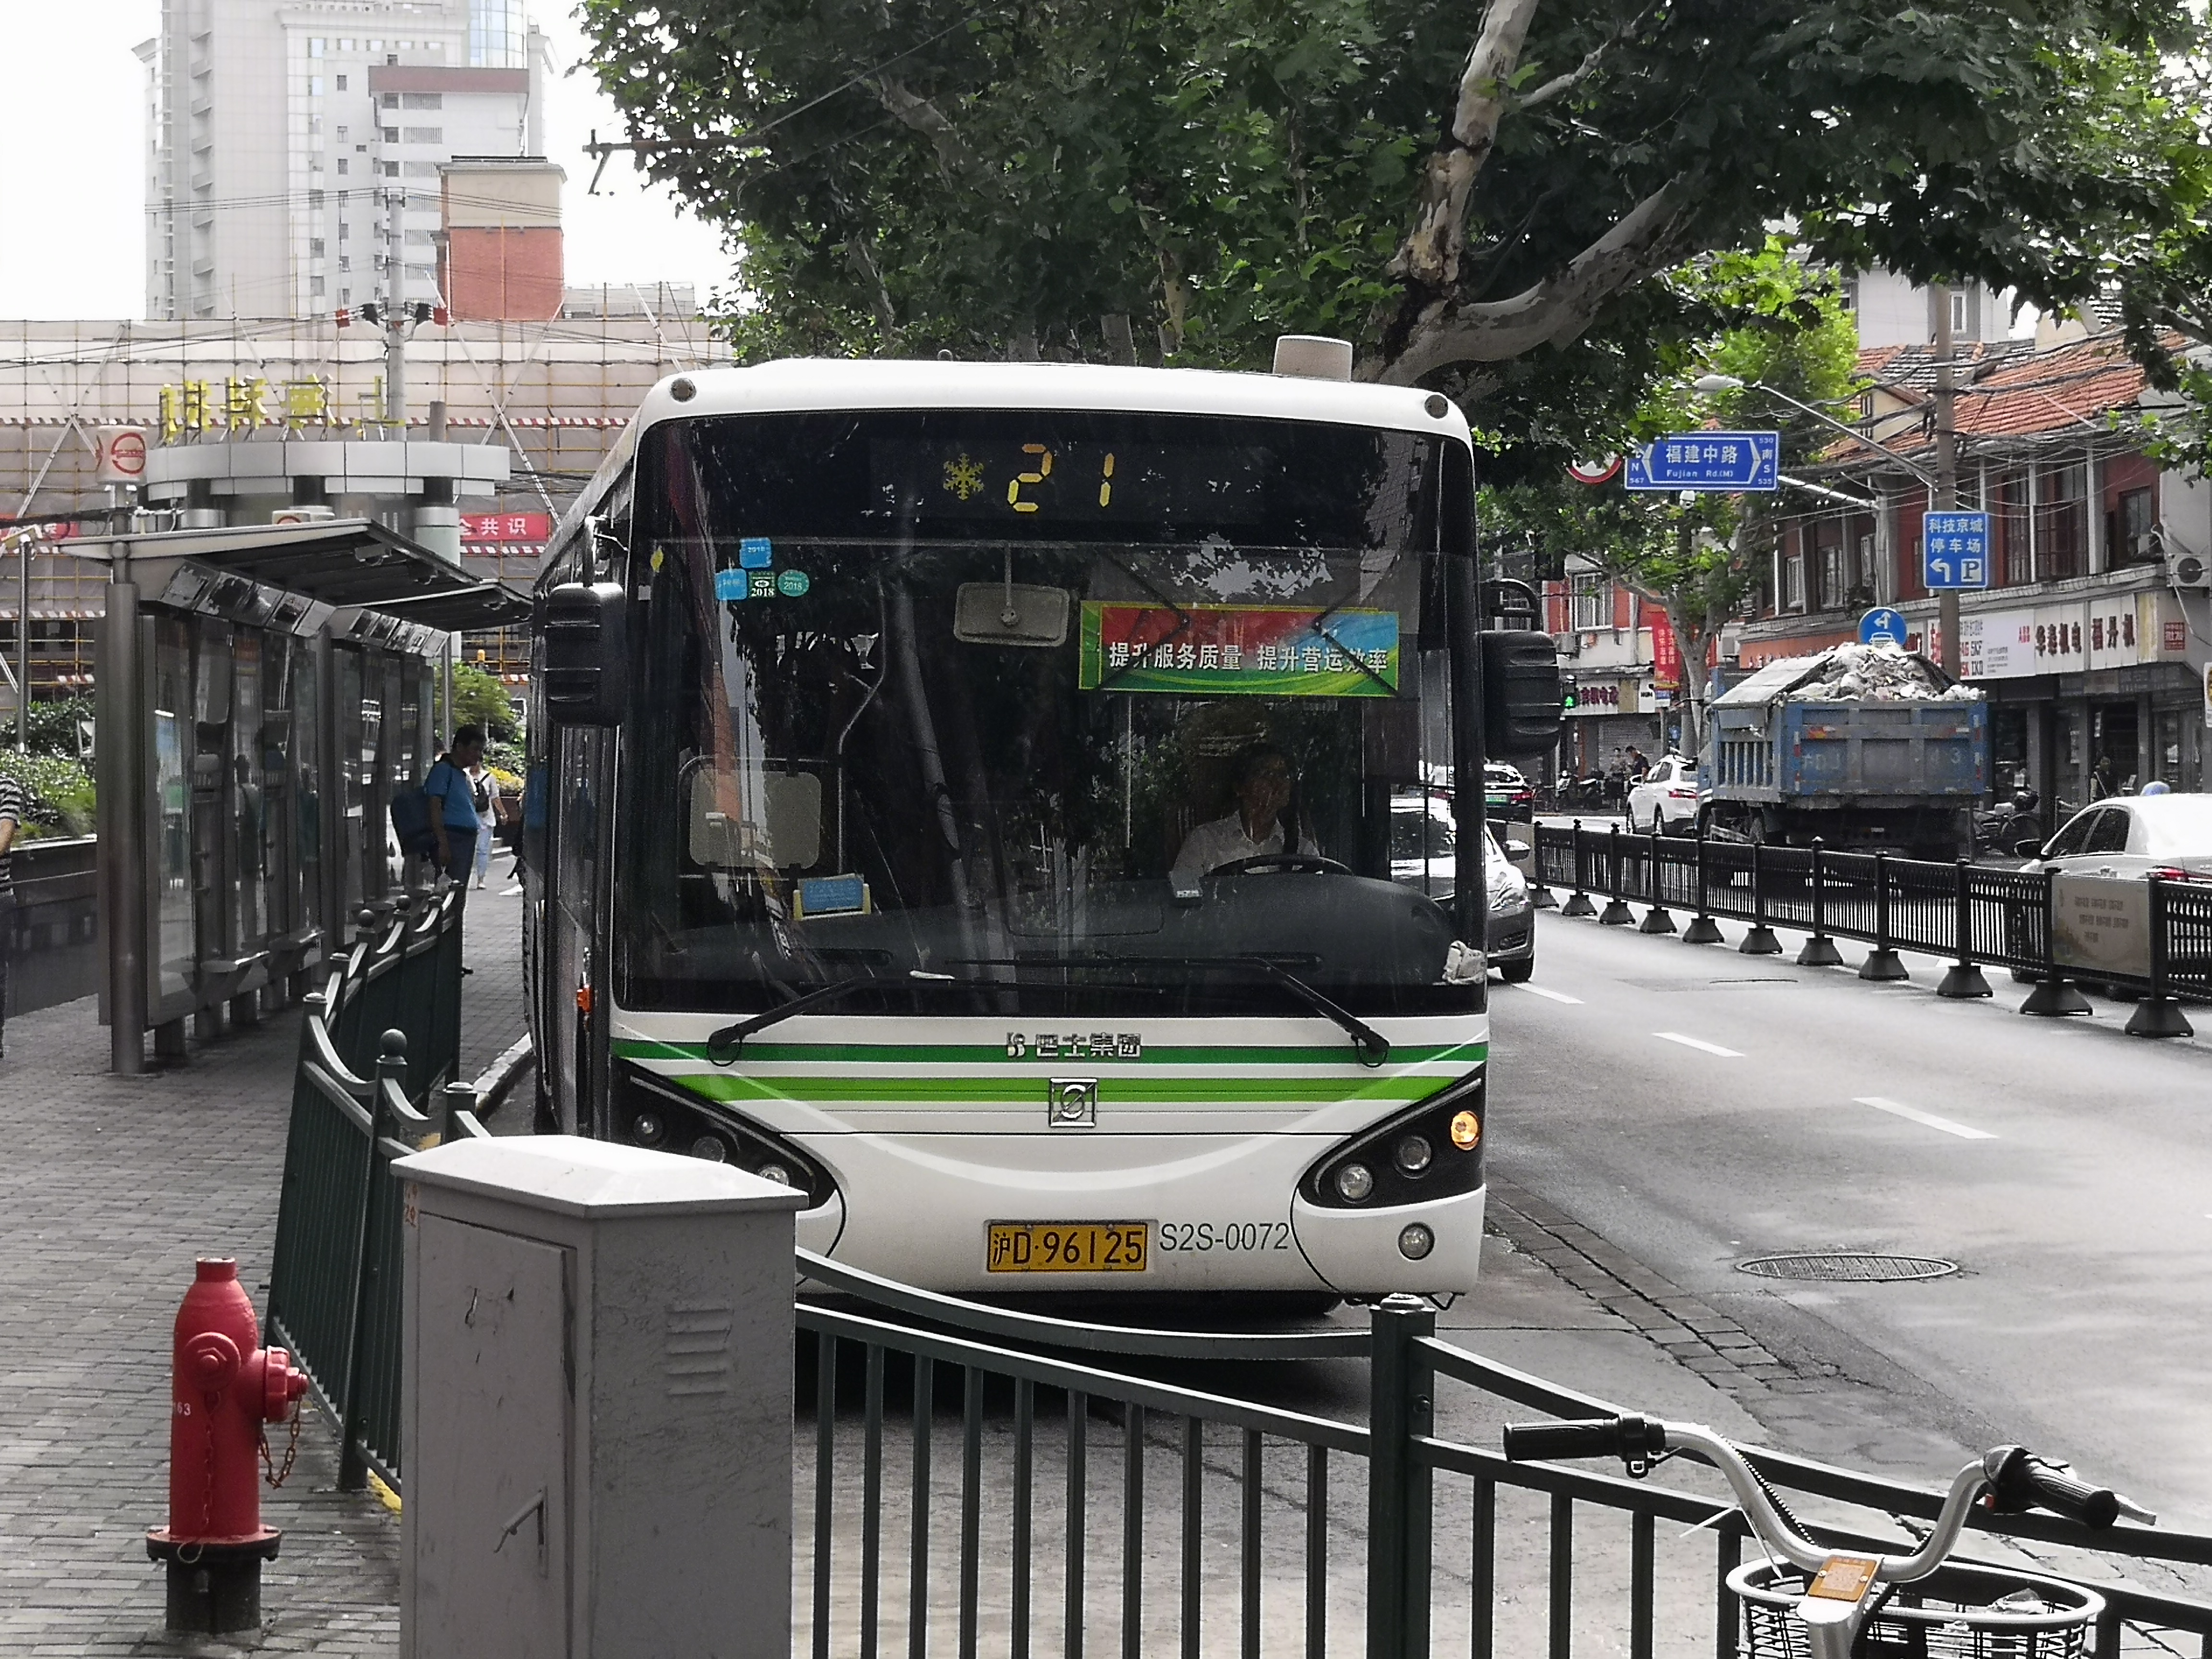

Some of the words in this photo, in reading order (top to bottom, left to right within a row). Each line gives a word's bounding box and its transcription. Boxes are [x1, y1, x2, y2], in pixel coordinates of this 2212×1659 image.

[1666, 445, 1738, 465] 福建中路
[1762, 449, 1773, 460] 南
[1631, 463, 1639, 471] N
[1764, 465, 1770, 473] S
[1008, 444, 1115, 512] 21
[1666, 469, 1698, 479] Fujian
[1929, 517, 1984, 533] 科技京城
[1931, 537, 1981, 553] 停车场
[751, 588, 775, 597] 2018
[783, 581, 803, 591] 2018
[1108, 641, 1244, 670] 提升服务质量
[1159, 1223, 1289, 1251] S2S-0072
